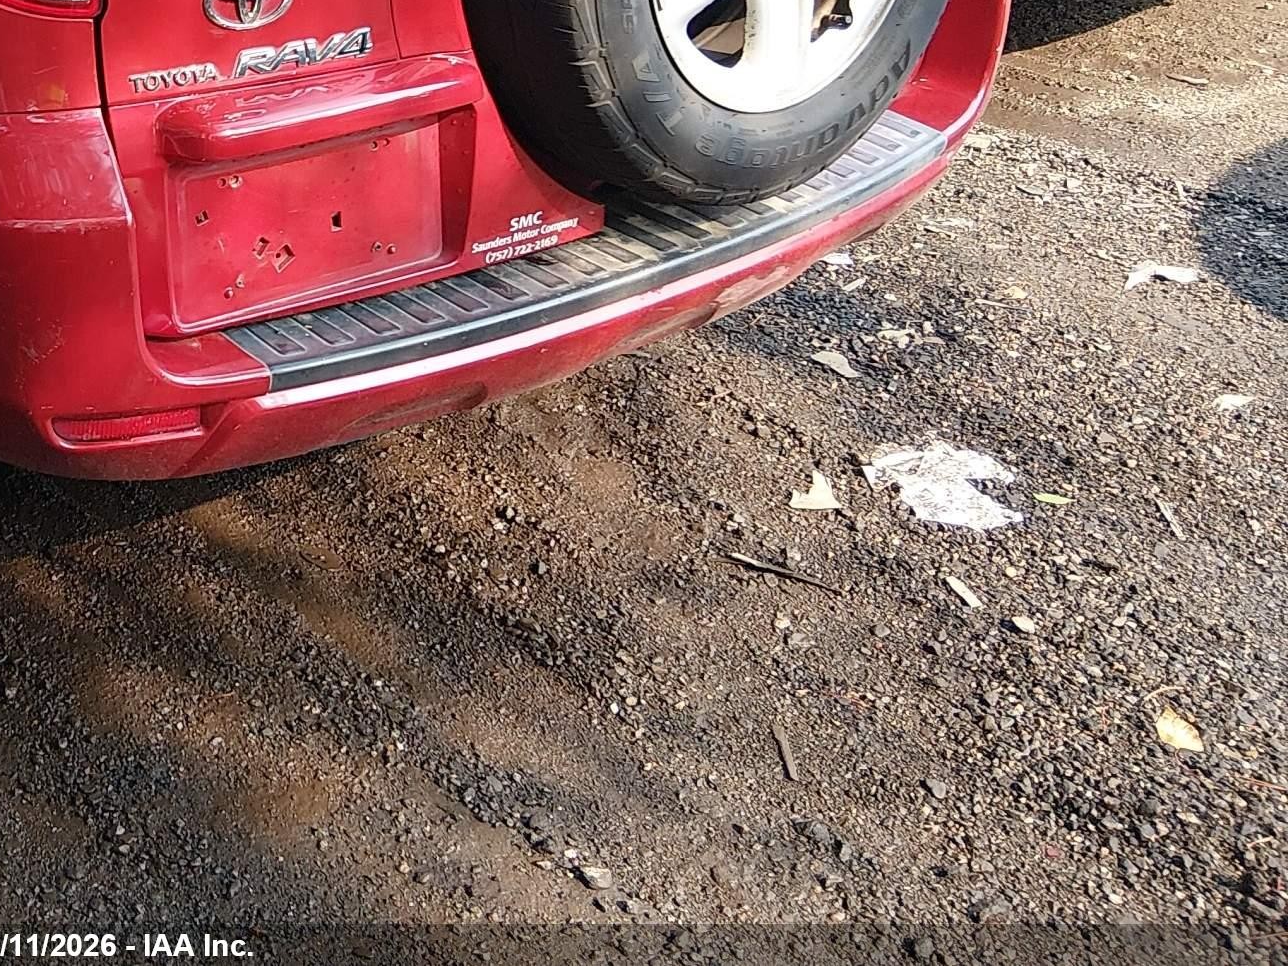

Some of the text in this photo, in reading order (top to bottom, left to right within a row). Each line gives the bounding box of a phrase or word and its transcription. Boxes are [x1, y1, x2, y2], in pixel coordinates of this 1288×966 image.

[128, 26, 374, 94] TOYOTA RAV4
[472, 217, 579, 253] Saunders Motor Company
[509, 211, 543, 232] SMC
[485, 235, 558, 264] (757) 722-2169
